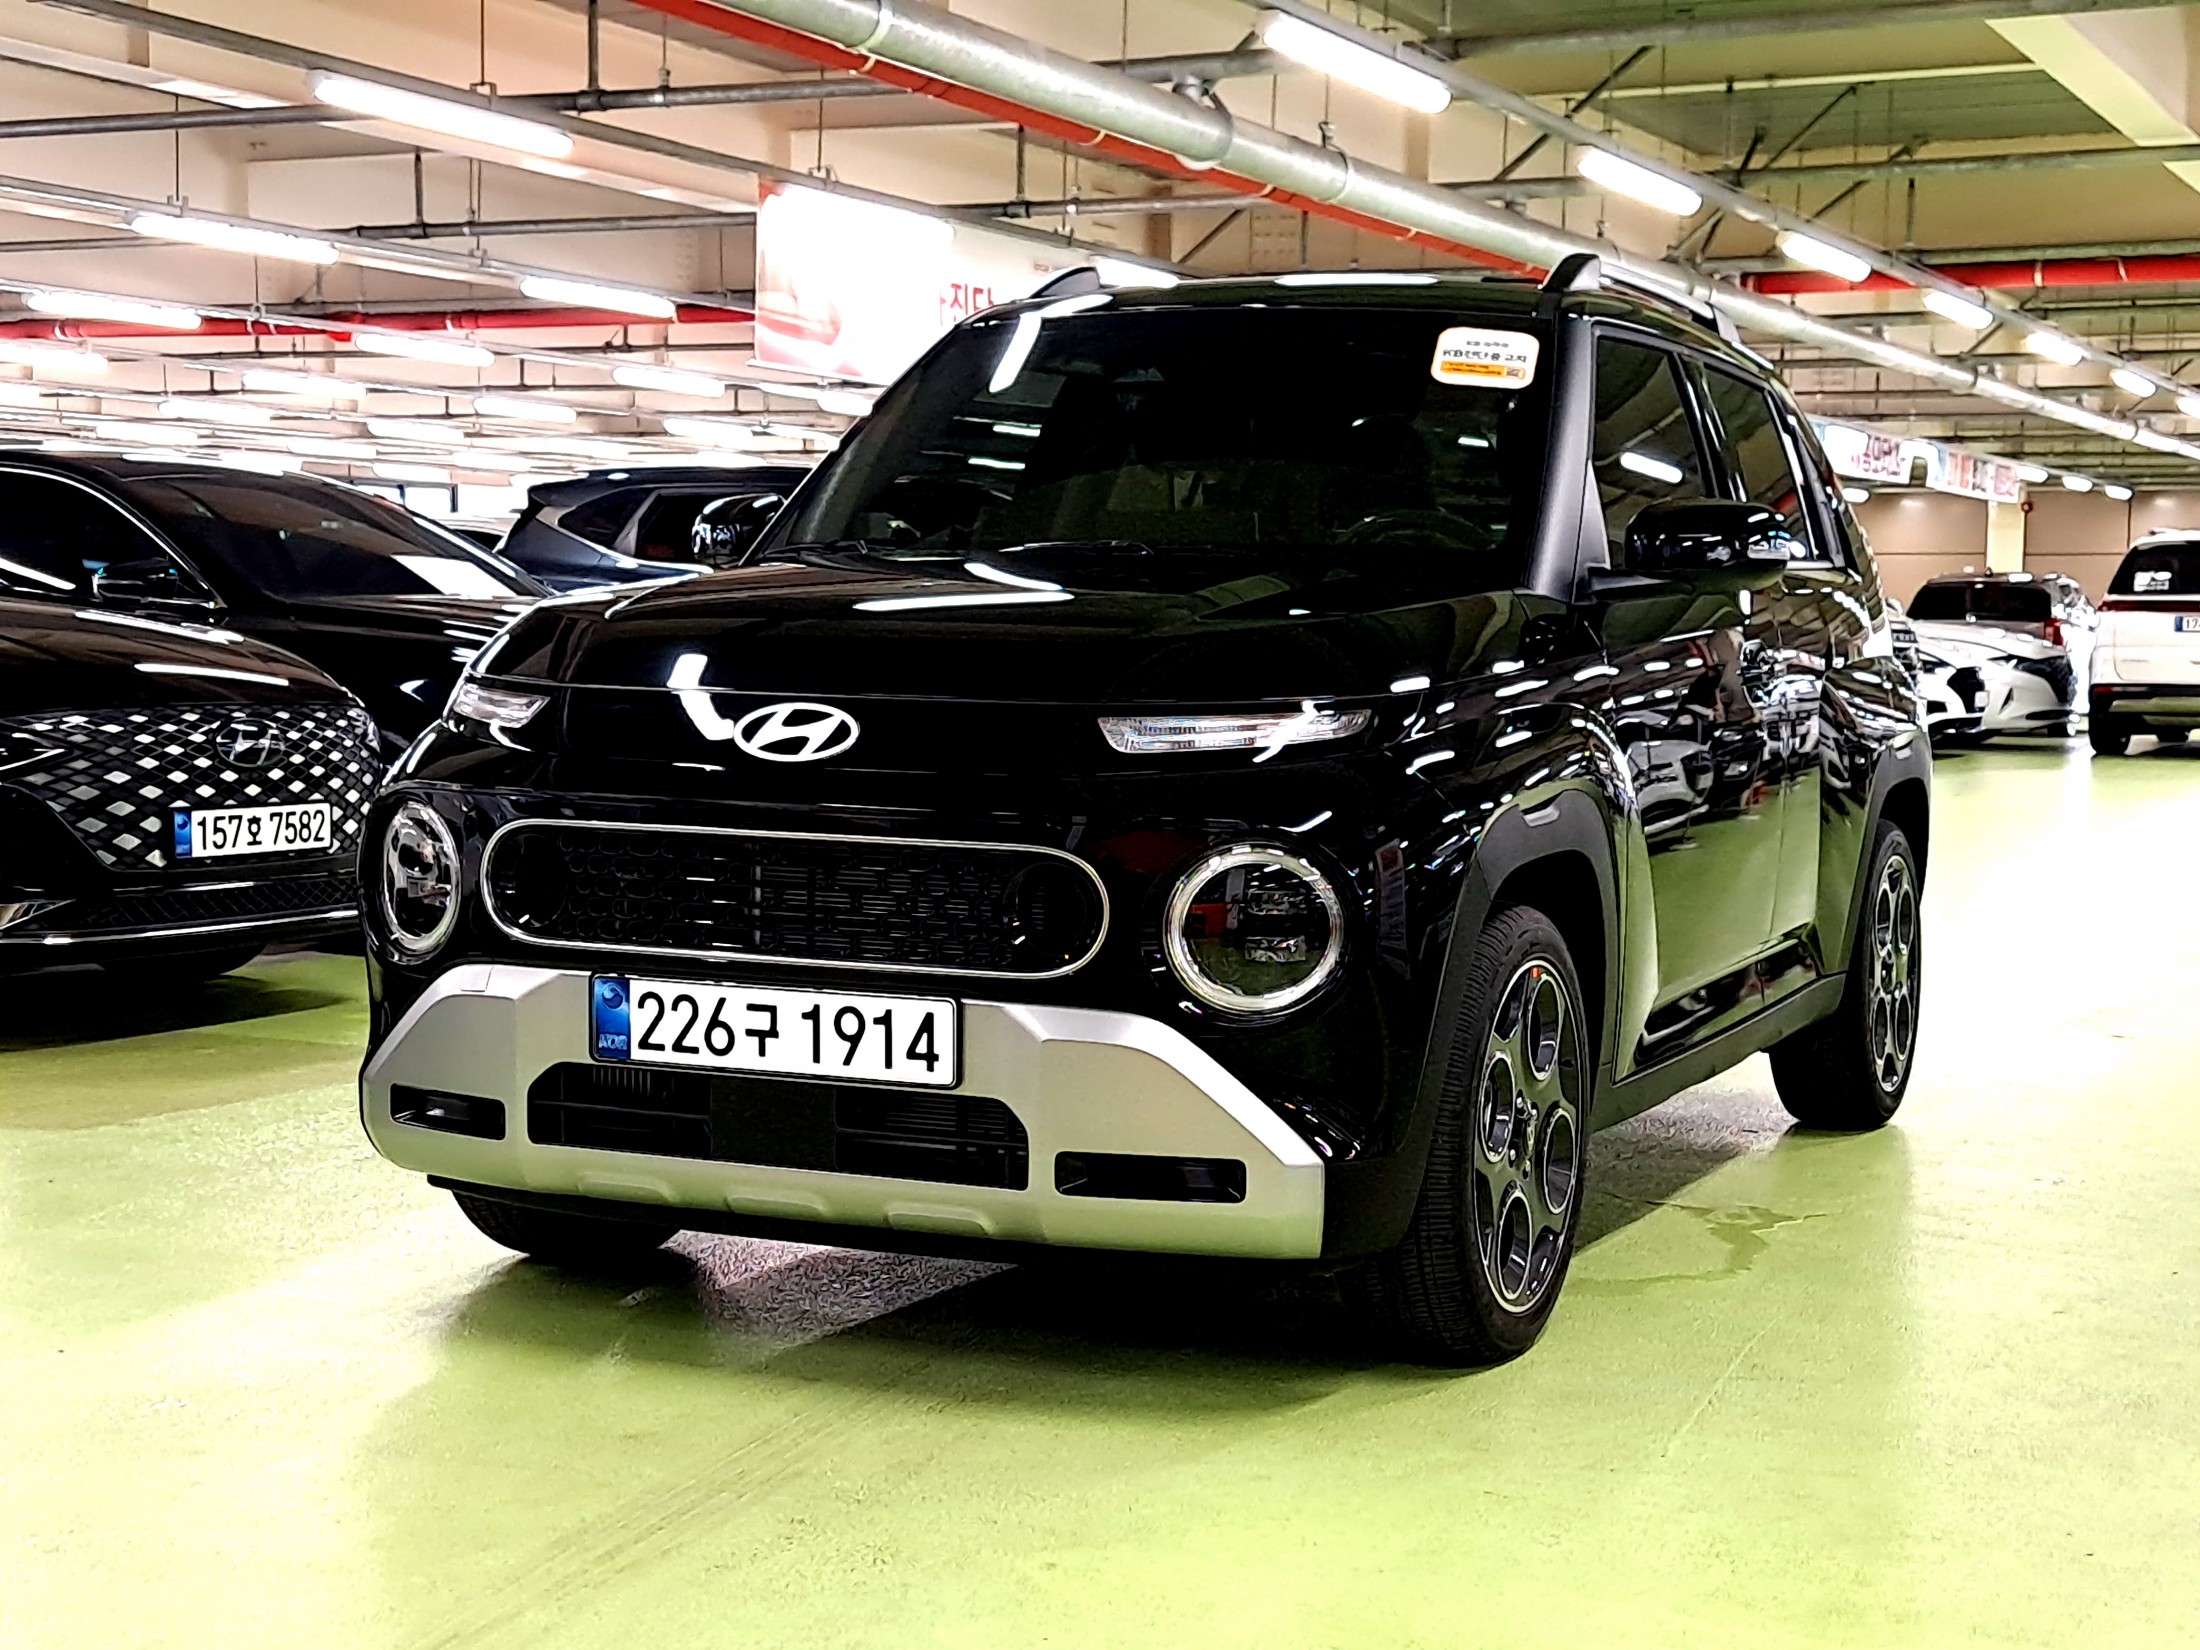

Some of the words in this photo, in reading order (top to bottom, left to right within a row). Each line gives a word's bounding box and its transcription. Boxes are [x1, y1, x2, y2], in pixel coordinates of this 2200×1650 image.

[197, 814, 262, 850] 157호
[269, 809, 325, 845] 7582
[637, 991, 779, 1057] 226구
[801, 1003, 939, 1073] 1914
